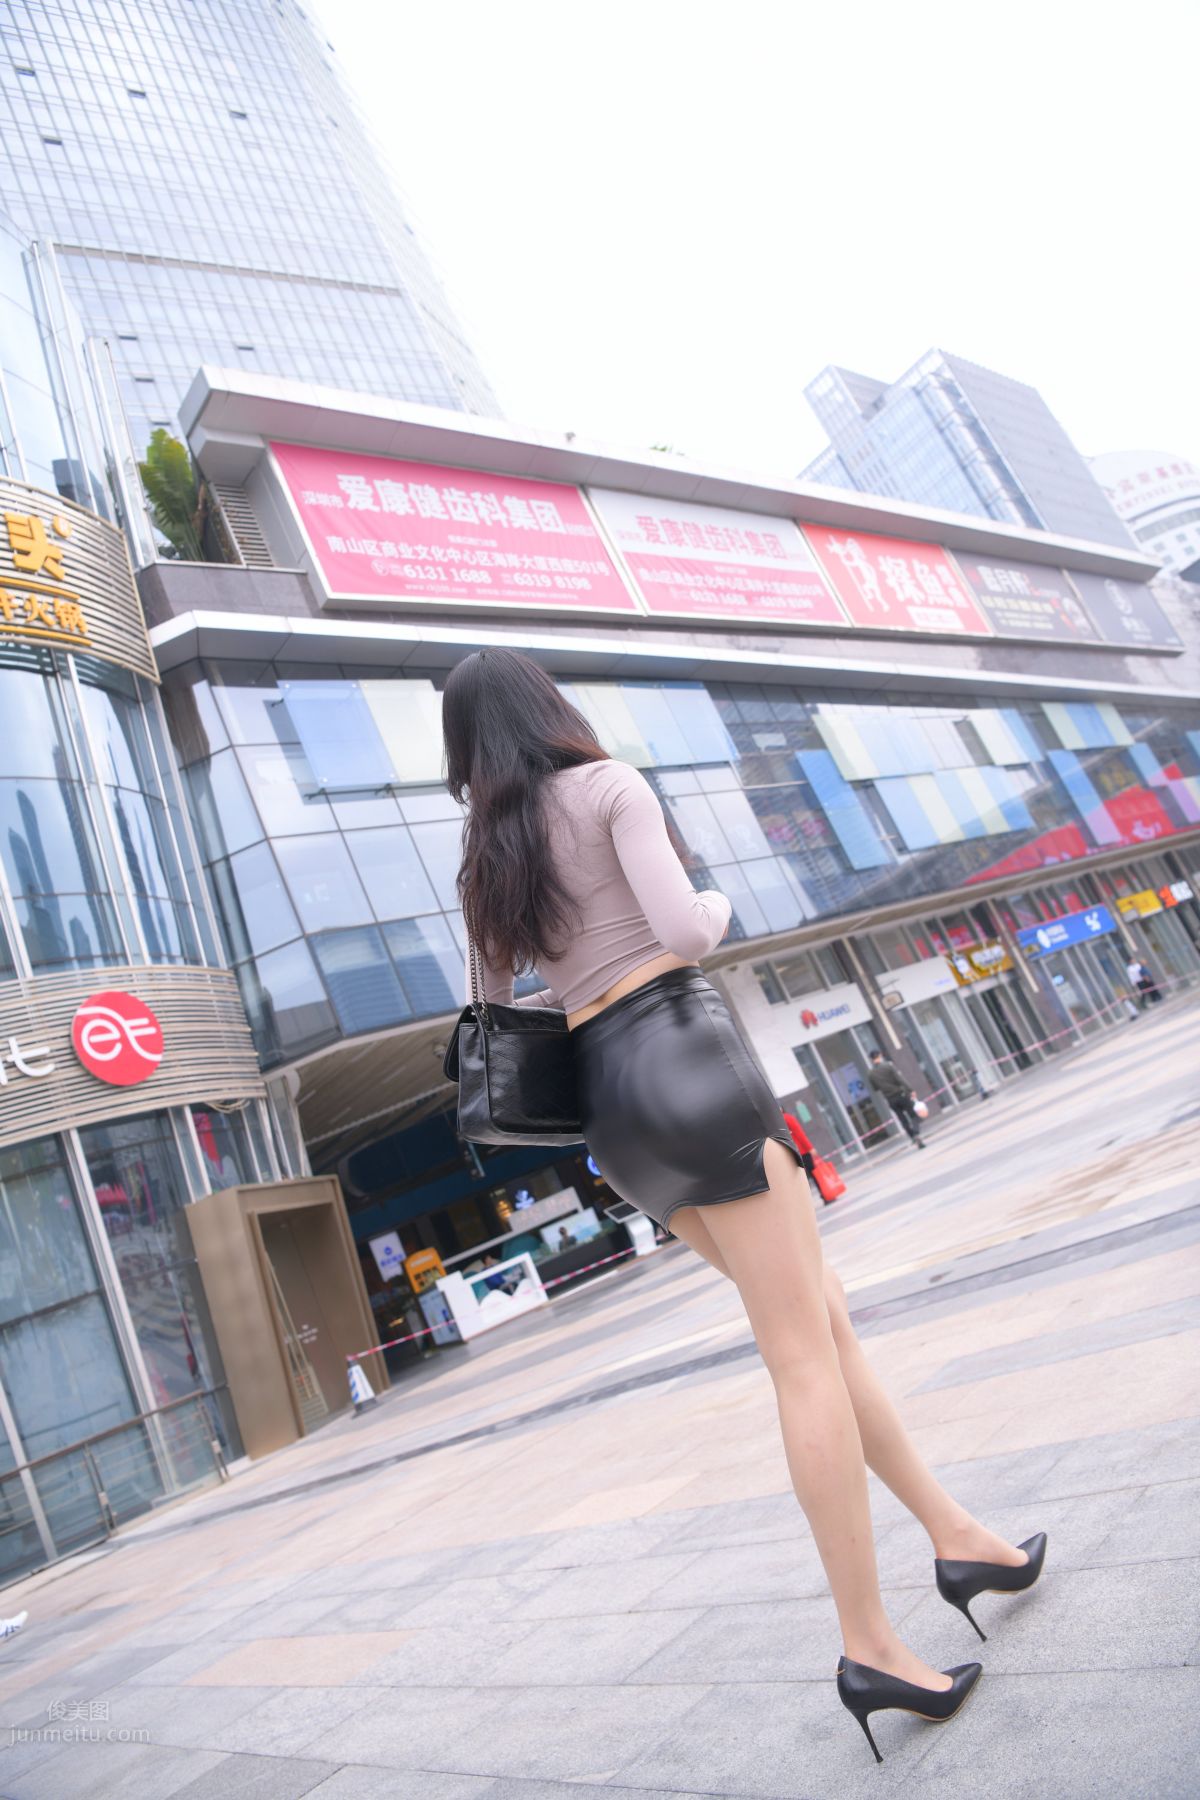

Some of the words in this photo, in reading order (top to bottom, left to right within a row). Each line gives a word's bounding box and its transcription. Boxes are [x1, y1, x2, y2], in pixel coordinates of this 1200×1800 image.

[337, 474, 566, 534] 爱康健齿科集团
[636, 516, 788, 559] 爱康健齿科集团
[403, 563, 448, 581] 6131
[450, 567, 492, 584] 1688
[817, 1003, 850, 1023] HUAWEI
